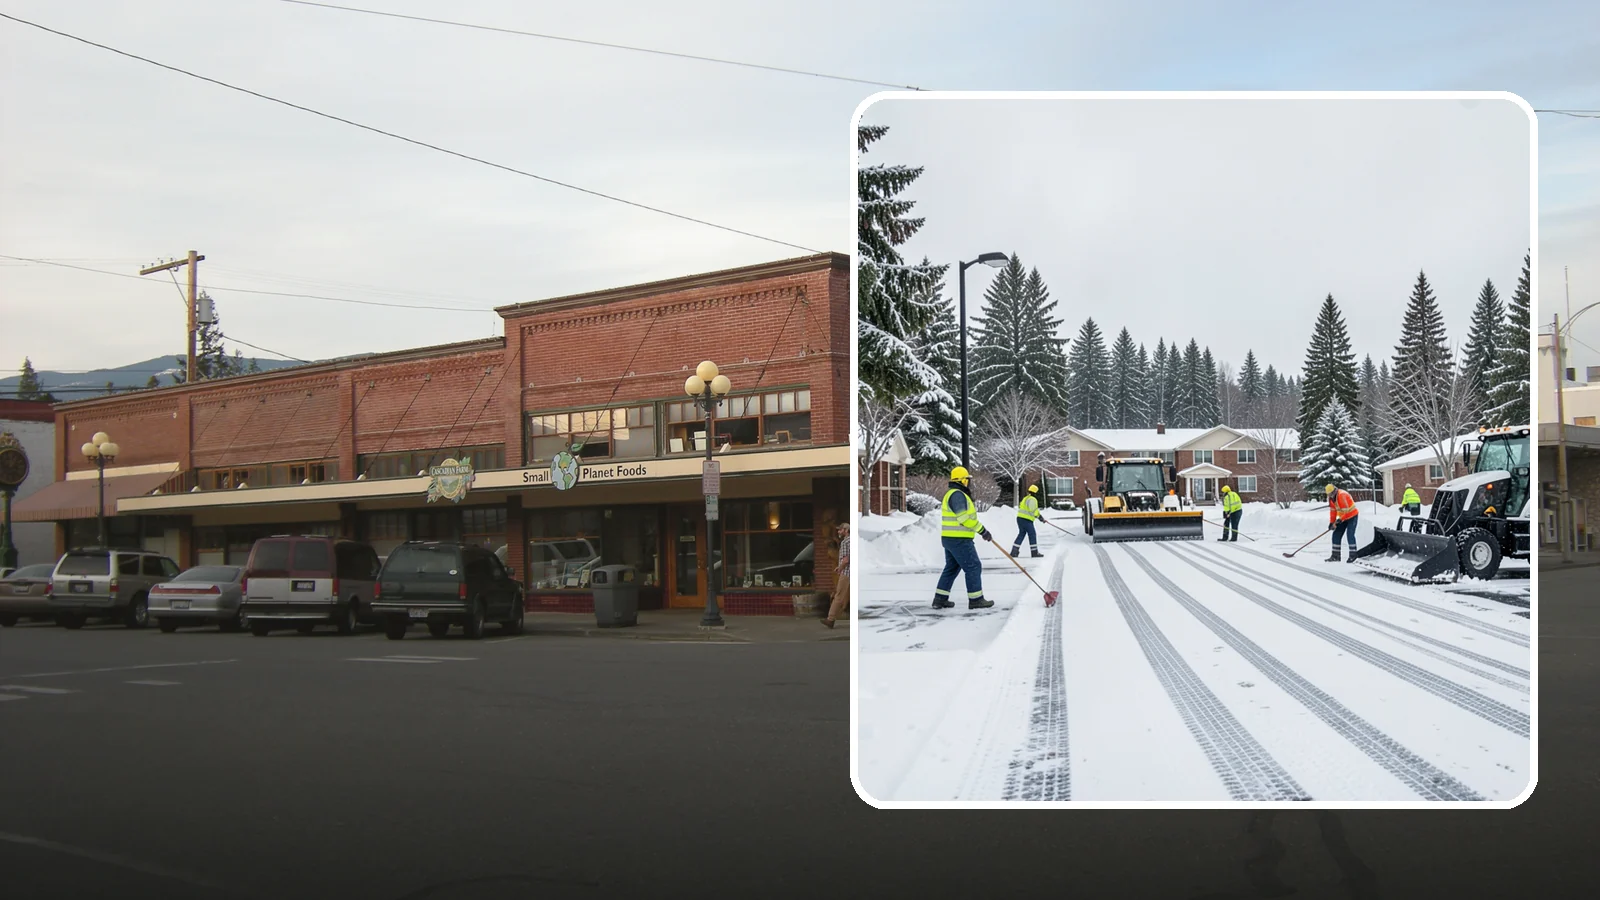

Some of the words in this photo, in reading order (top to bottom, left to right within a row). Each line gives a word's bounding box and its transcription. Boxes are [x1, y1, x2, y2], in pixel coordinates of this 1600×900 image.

[523, 471, 549, 483] Small
[583, 467, 614, 479] Planet
[617, 464, 647, 477] Foods
